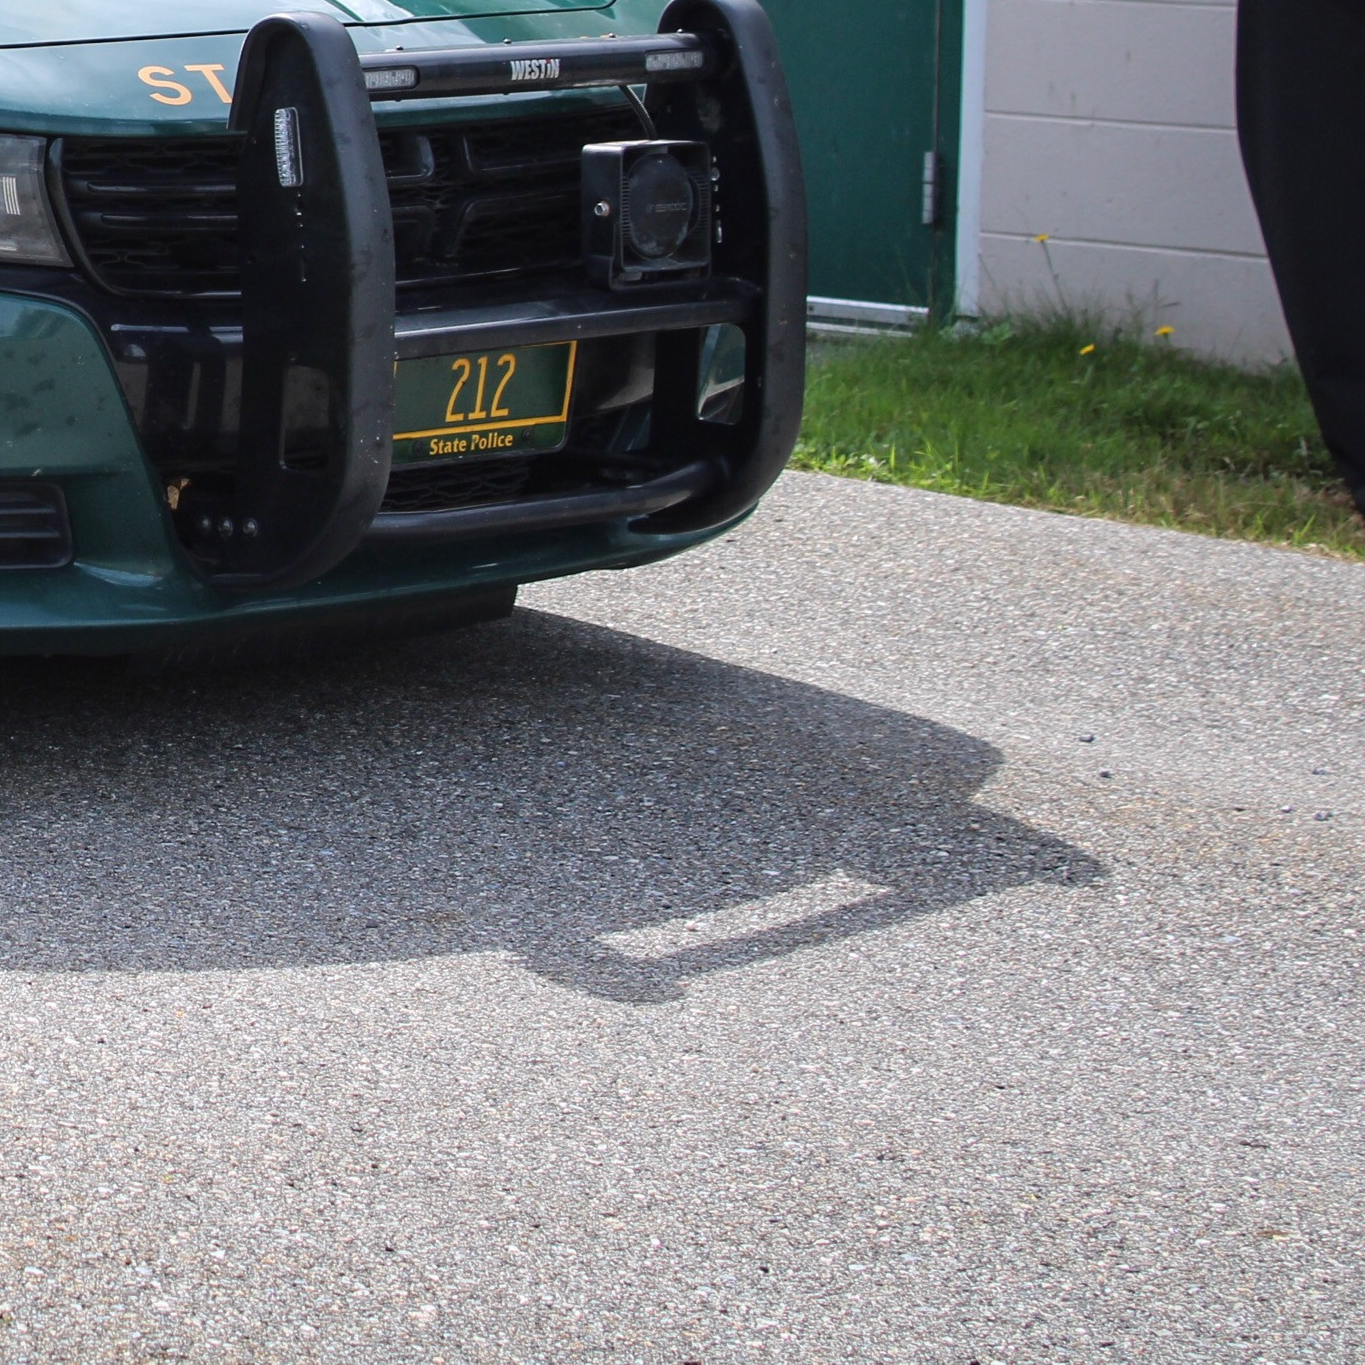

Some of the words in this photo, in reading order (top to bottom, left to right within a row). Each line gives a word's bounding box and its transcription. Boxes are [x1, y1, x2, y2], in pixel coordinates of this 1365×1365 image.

[445, 353, 517, 423] 212
[429, 438, 468, 456] State
[470, 432, 514, 452] Police
